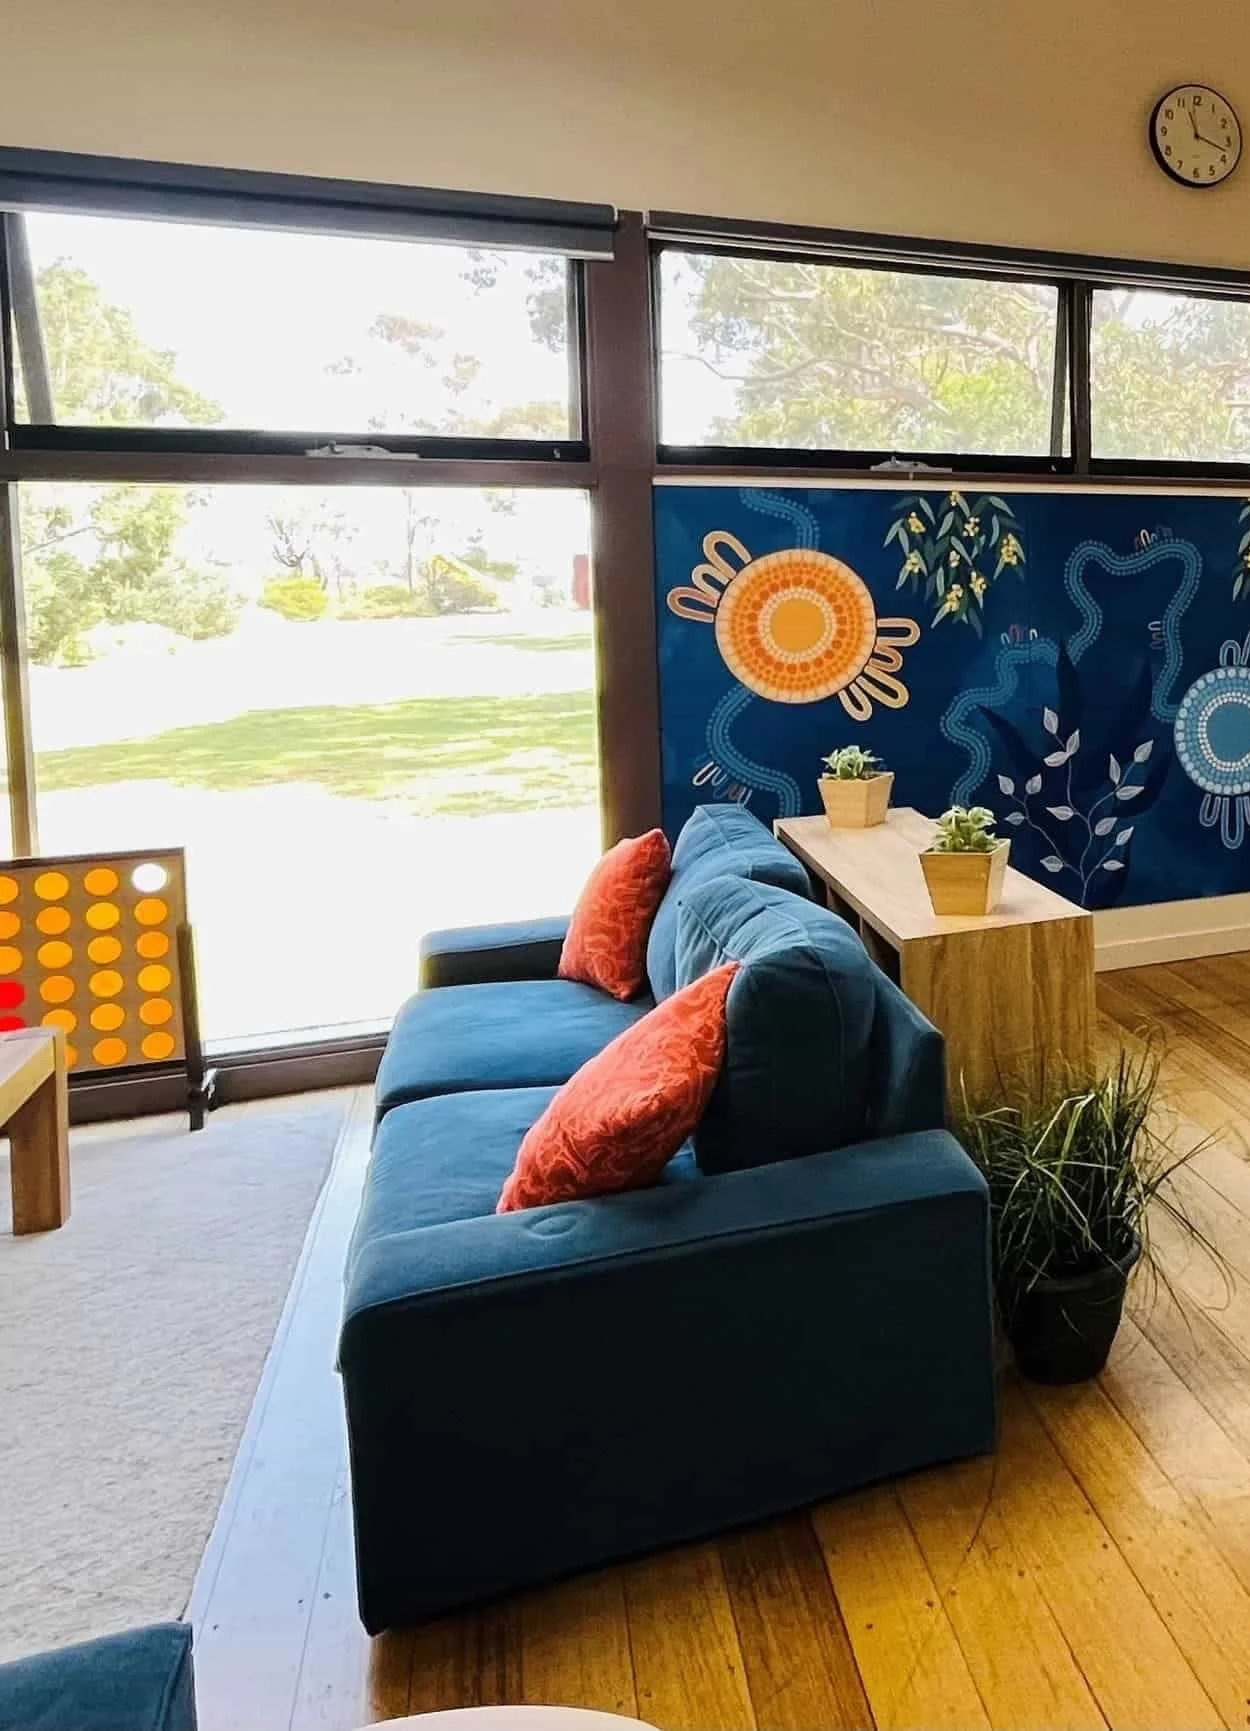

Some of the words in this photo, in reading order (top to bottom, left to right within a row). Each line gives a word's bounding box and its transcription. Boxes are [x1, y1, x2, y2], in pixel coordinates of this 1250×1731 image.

[1177, 98, 1185, 108] 11
[1193, 95, 1202, 106] 12
[1165, 109, 1174, 120] 10
[1220, 118, 1227, 129] 2
[1160, 126, 1168, 136] 9
[1225, 136, 1231, 147] 3
[1165, 145, 1172, 156] 8
[1177, 160, 1183, 169] 7
[1220, 154, 1227, 164] 4
[1193, 168, 1200, 178] 6
[1209, 165, 1215, 176] 5
